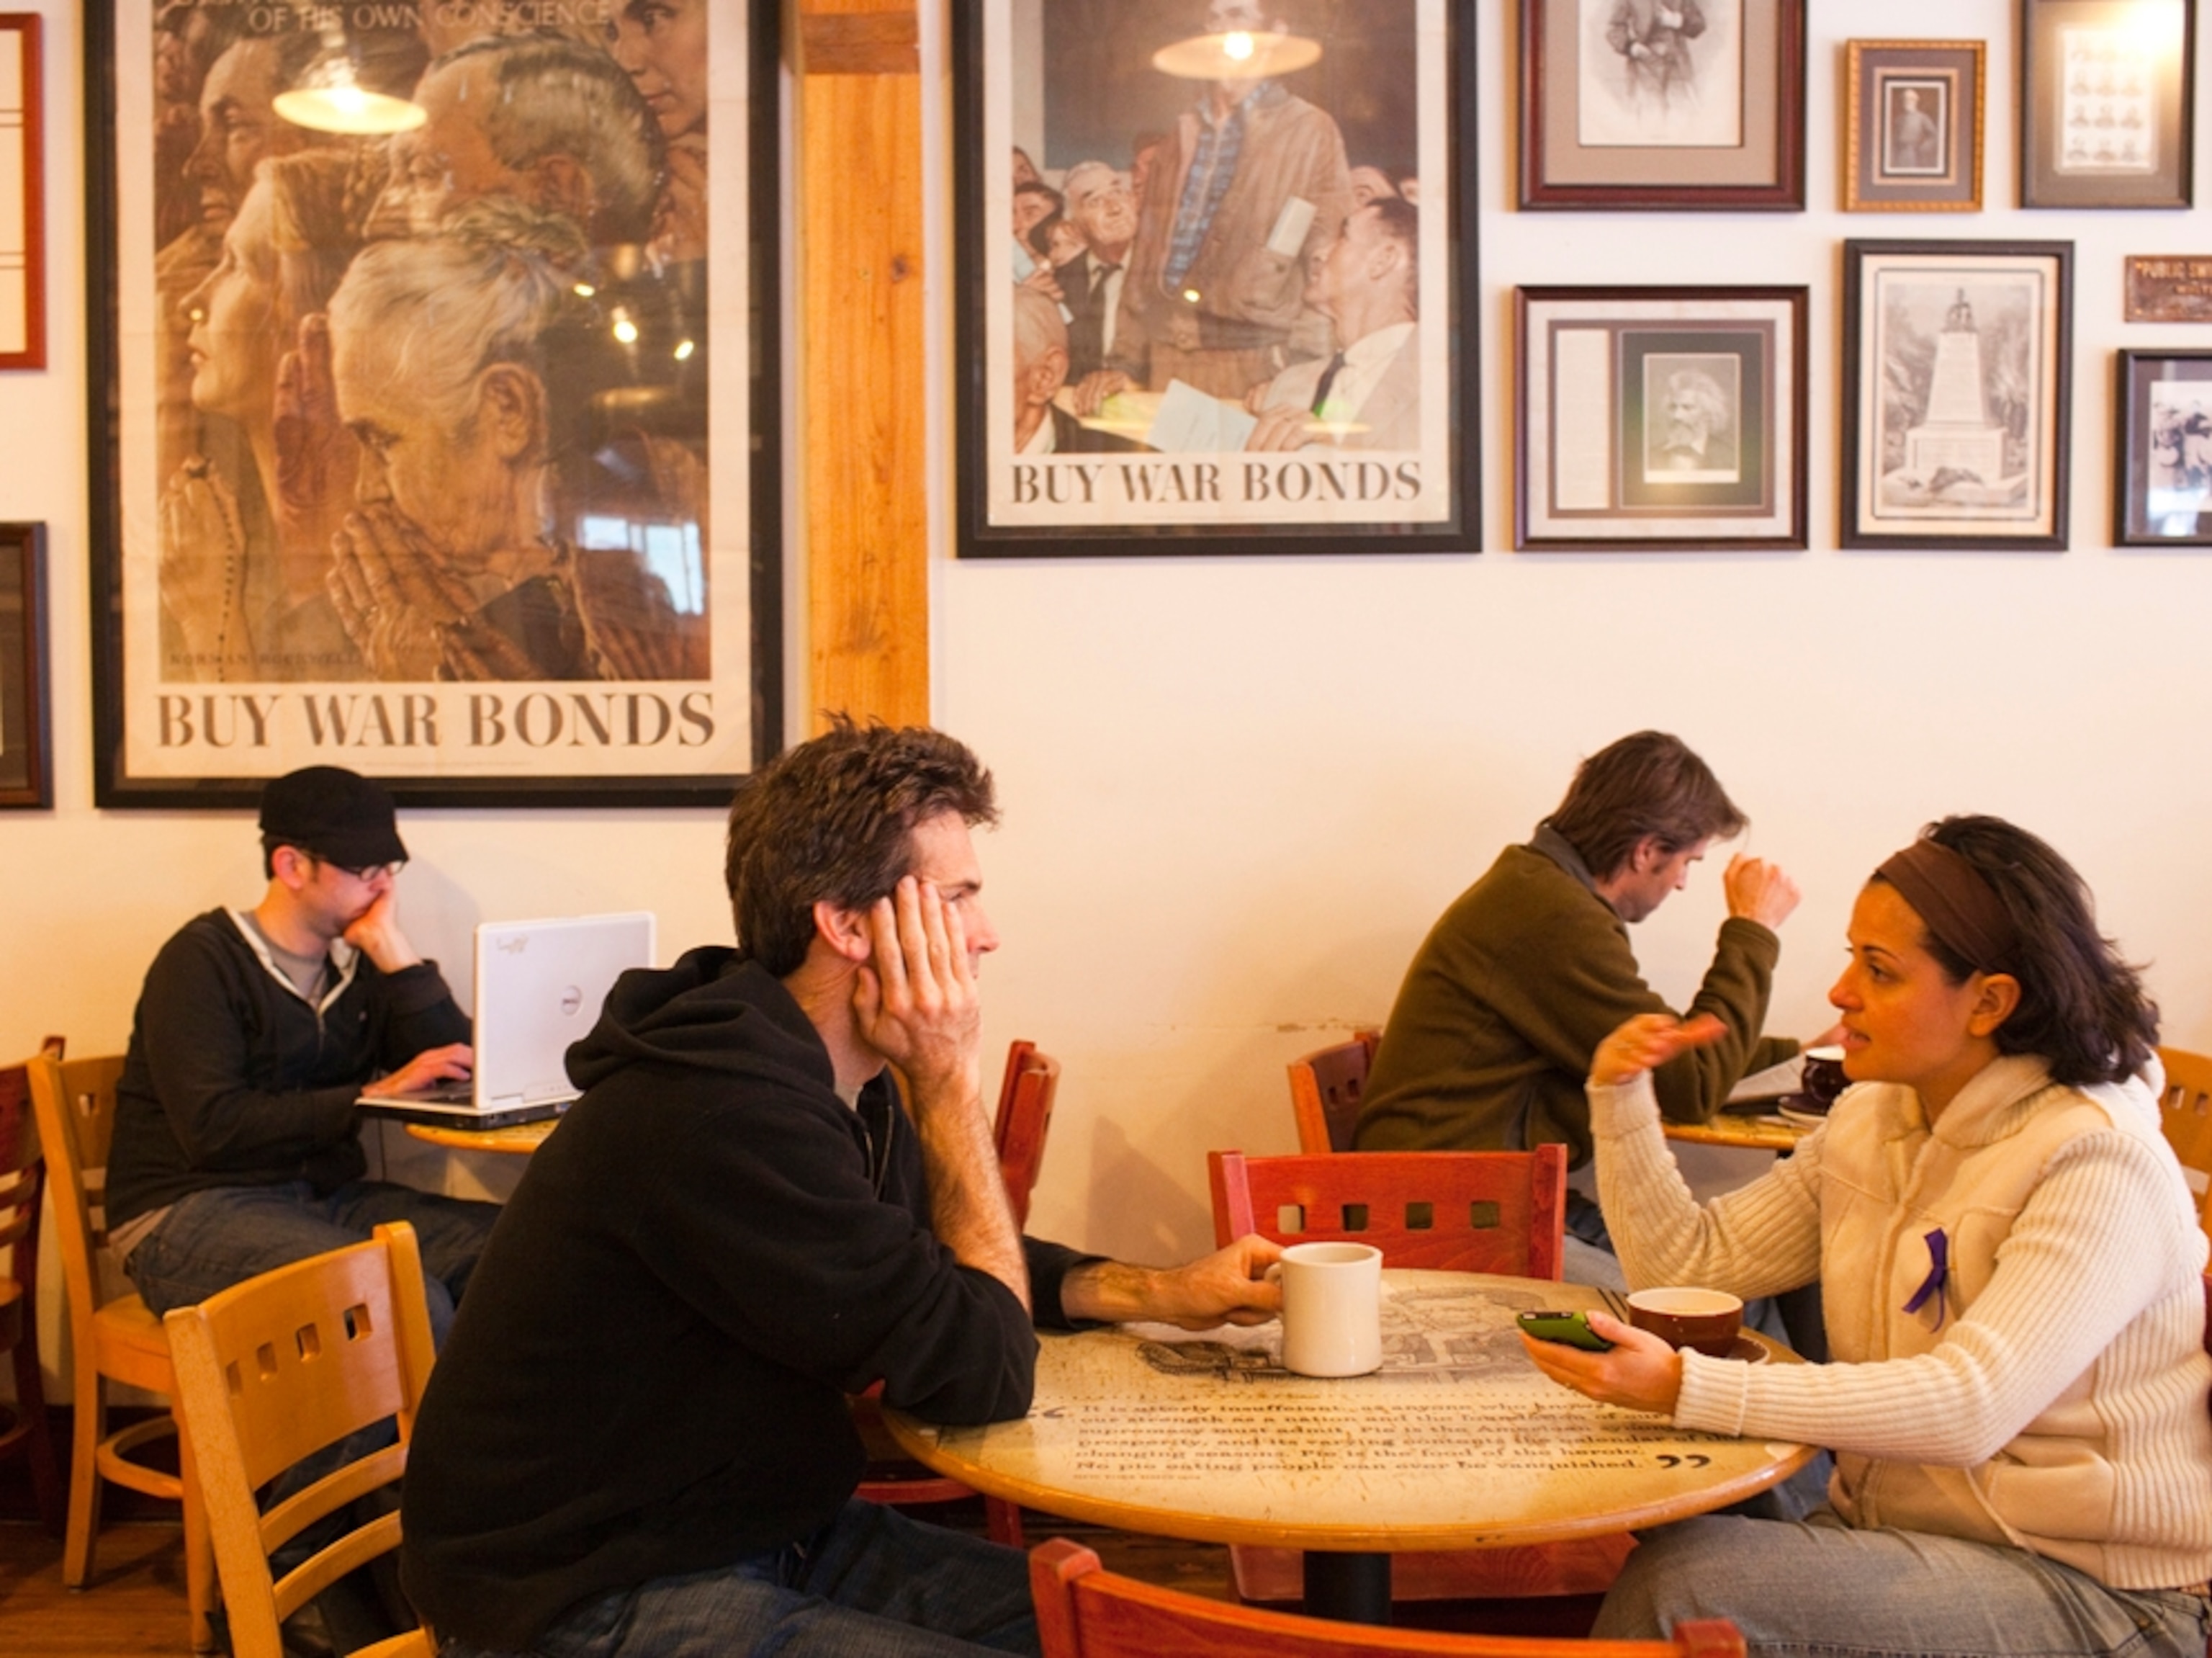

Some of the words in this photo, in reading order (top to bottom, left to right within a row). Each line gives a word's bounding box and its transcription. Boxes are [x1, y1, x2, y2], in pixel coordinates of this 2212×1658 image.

[248, 6, 288, 32] OF
[352, 3, 426, 30] OWN
[434, 1, 611, 28] CONSCIENCE
[1010, 463, 1104, 503] BUY
[1117, 462, 1221, 503] WAR
[1241, 460, 1422, 501] BONDS
[155, 693, 282, 748] BUY
[297, 692, 442, 747] WAR
[465, 691, 715, 747] BONDS
[1134, 1404, 1211, 1414] utterly
[1480, 1402, 1527, 1411] who
[1128, 1415, 1223, 1424] strength
[1365, 1414, 1408, 1422] and
[1460, 1413, 1586, 1422] foundation
[1217, 1437, 1261, 1446] and
[1306, 1438, 1395, 1447] varying
[1514, 1435, 1551, 1444] the
[1560, 1434, 1665, 1444] calendar
[1075, 1449, 1186, 1459] changing
[1421, 1448, 1473, 1457] food
[1119, 1463, 1157, 1471] pie
[1165, 1463, 1243, 1471] eating
[1251, 1461, 1335, 1471] people
